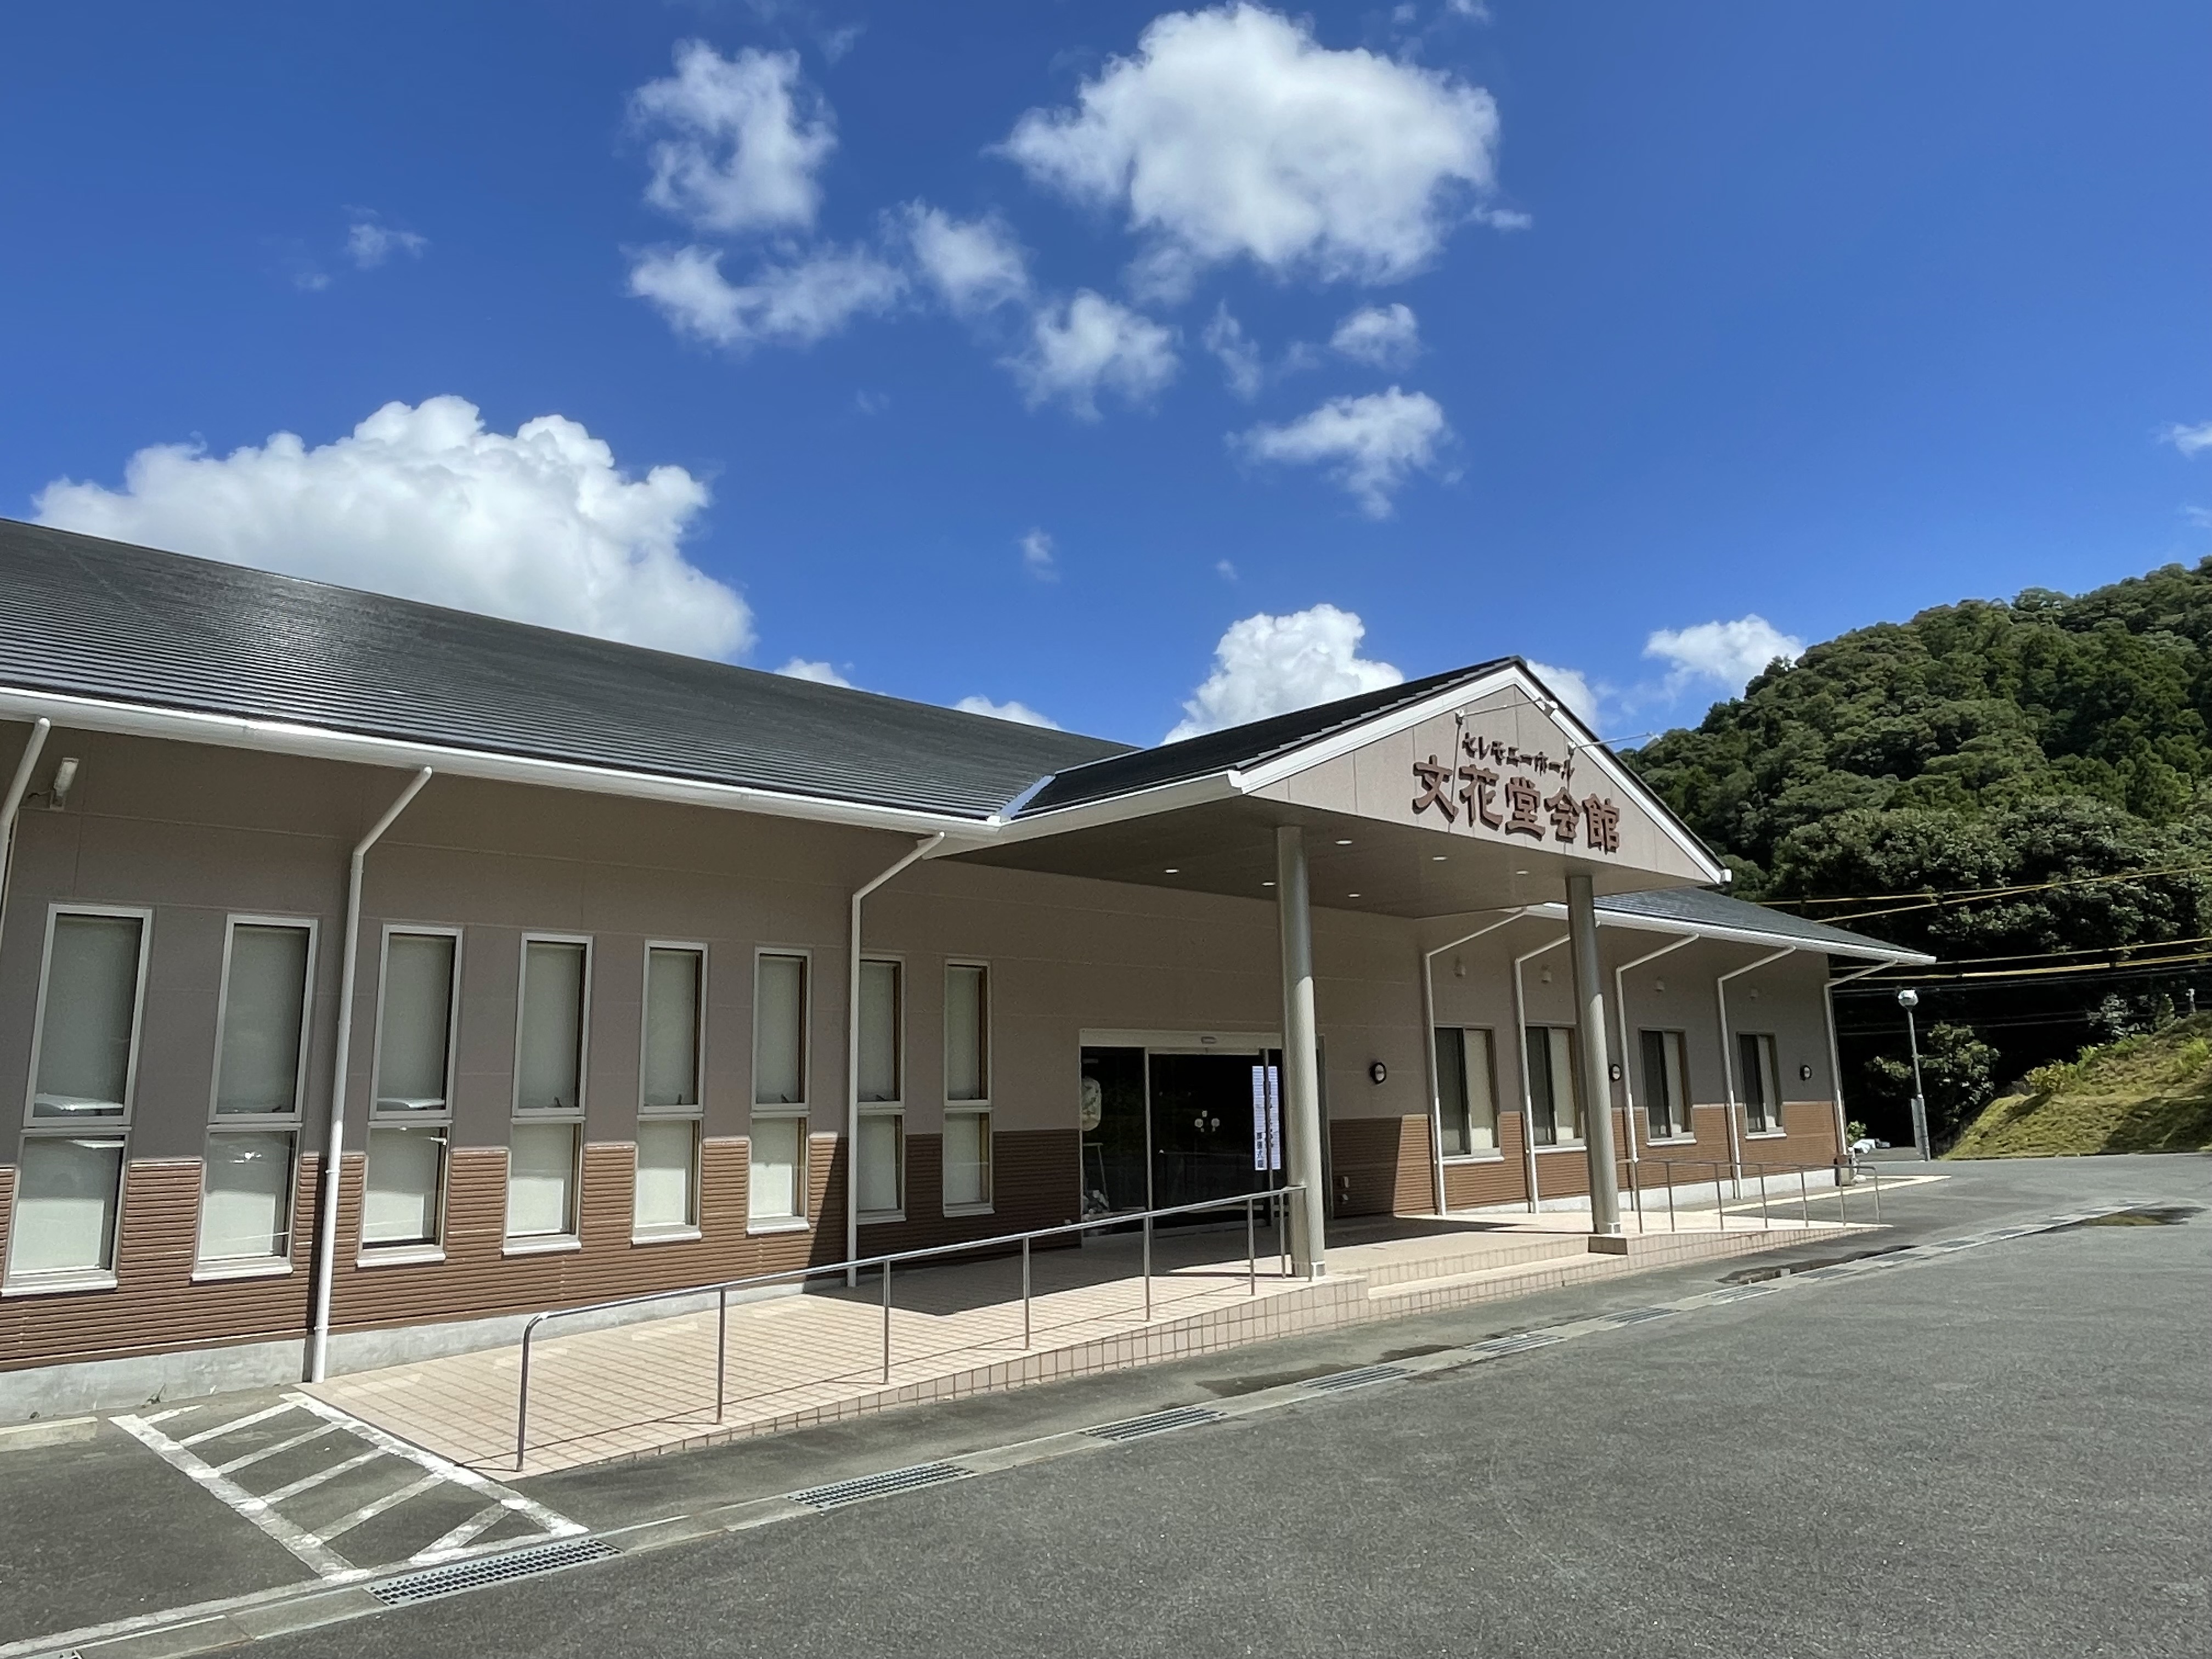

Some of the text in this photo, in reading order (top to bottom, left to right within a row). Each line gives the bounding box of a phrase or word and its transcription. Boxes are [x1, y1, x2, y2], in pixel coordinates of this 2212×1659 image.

[1462, 732, 1575, 779] セレモニーホール
[1412, 755, 1621, 854] 文花堂会館
